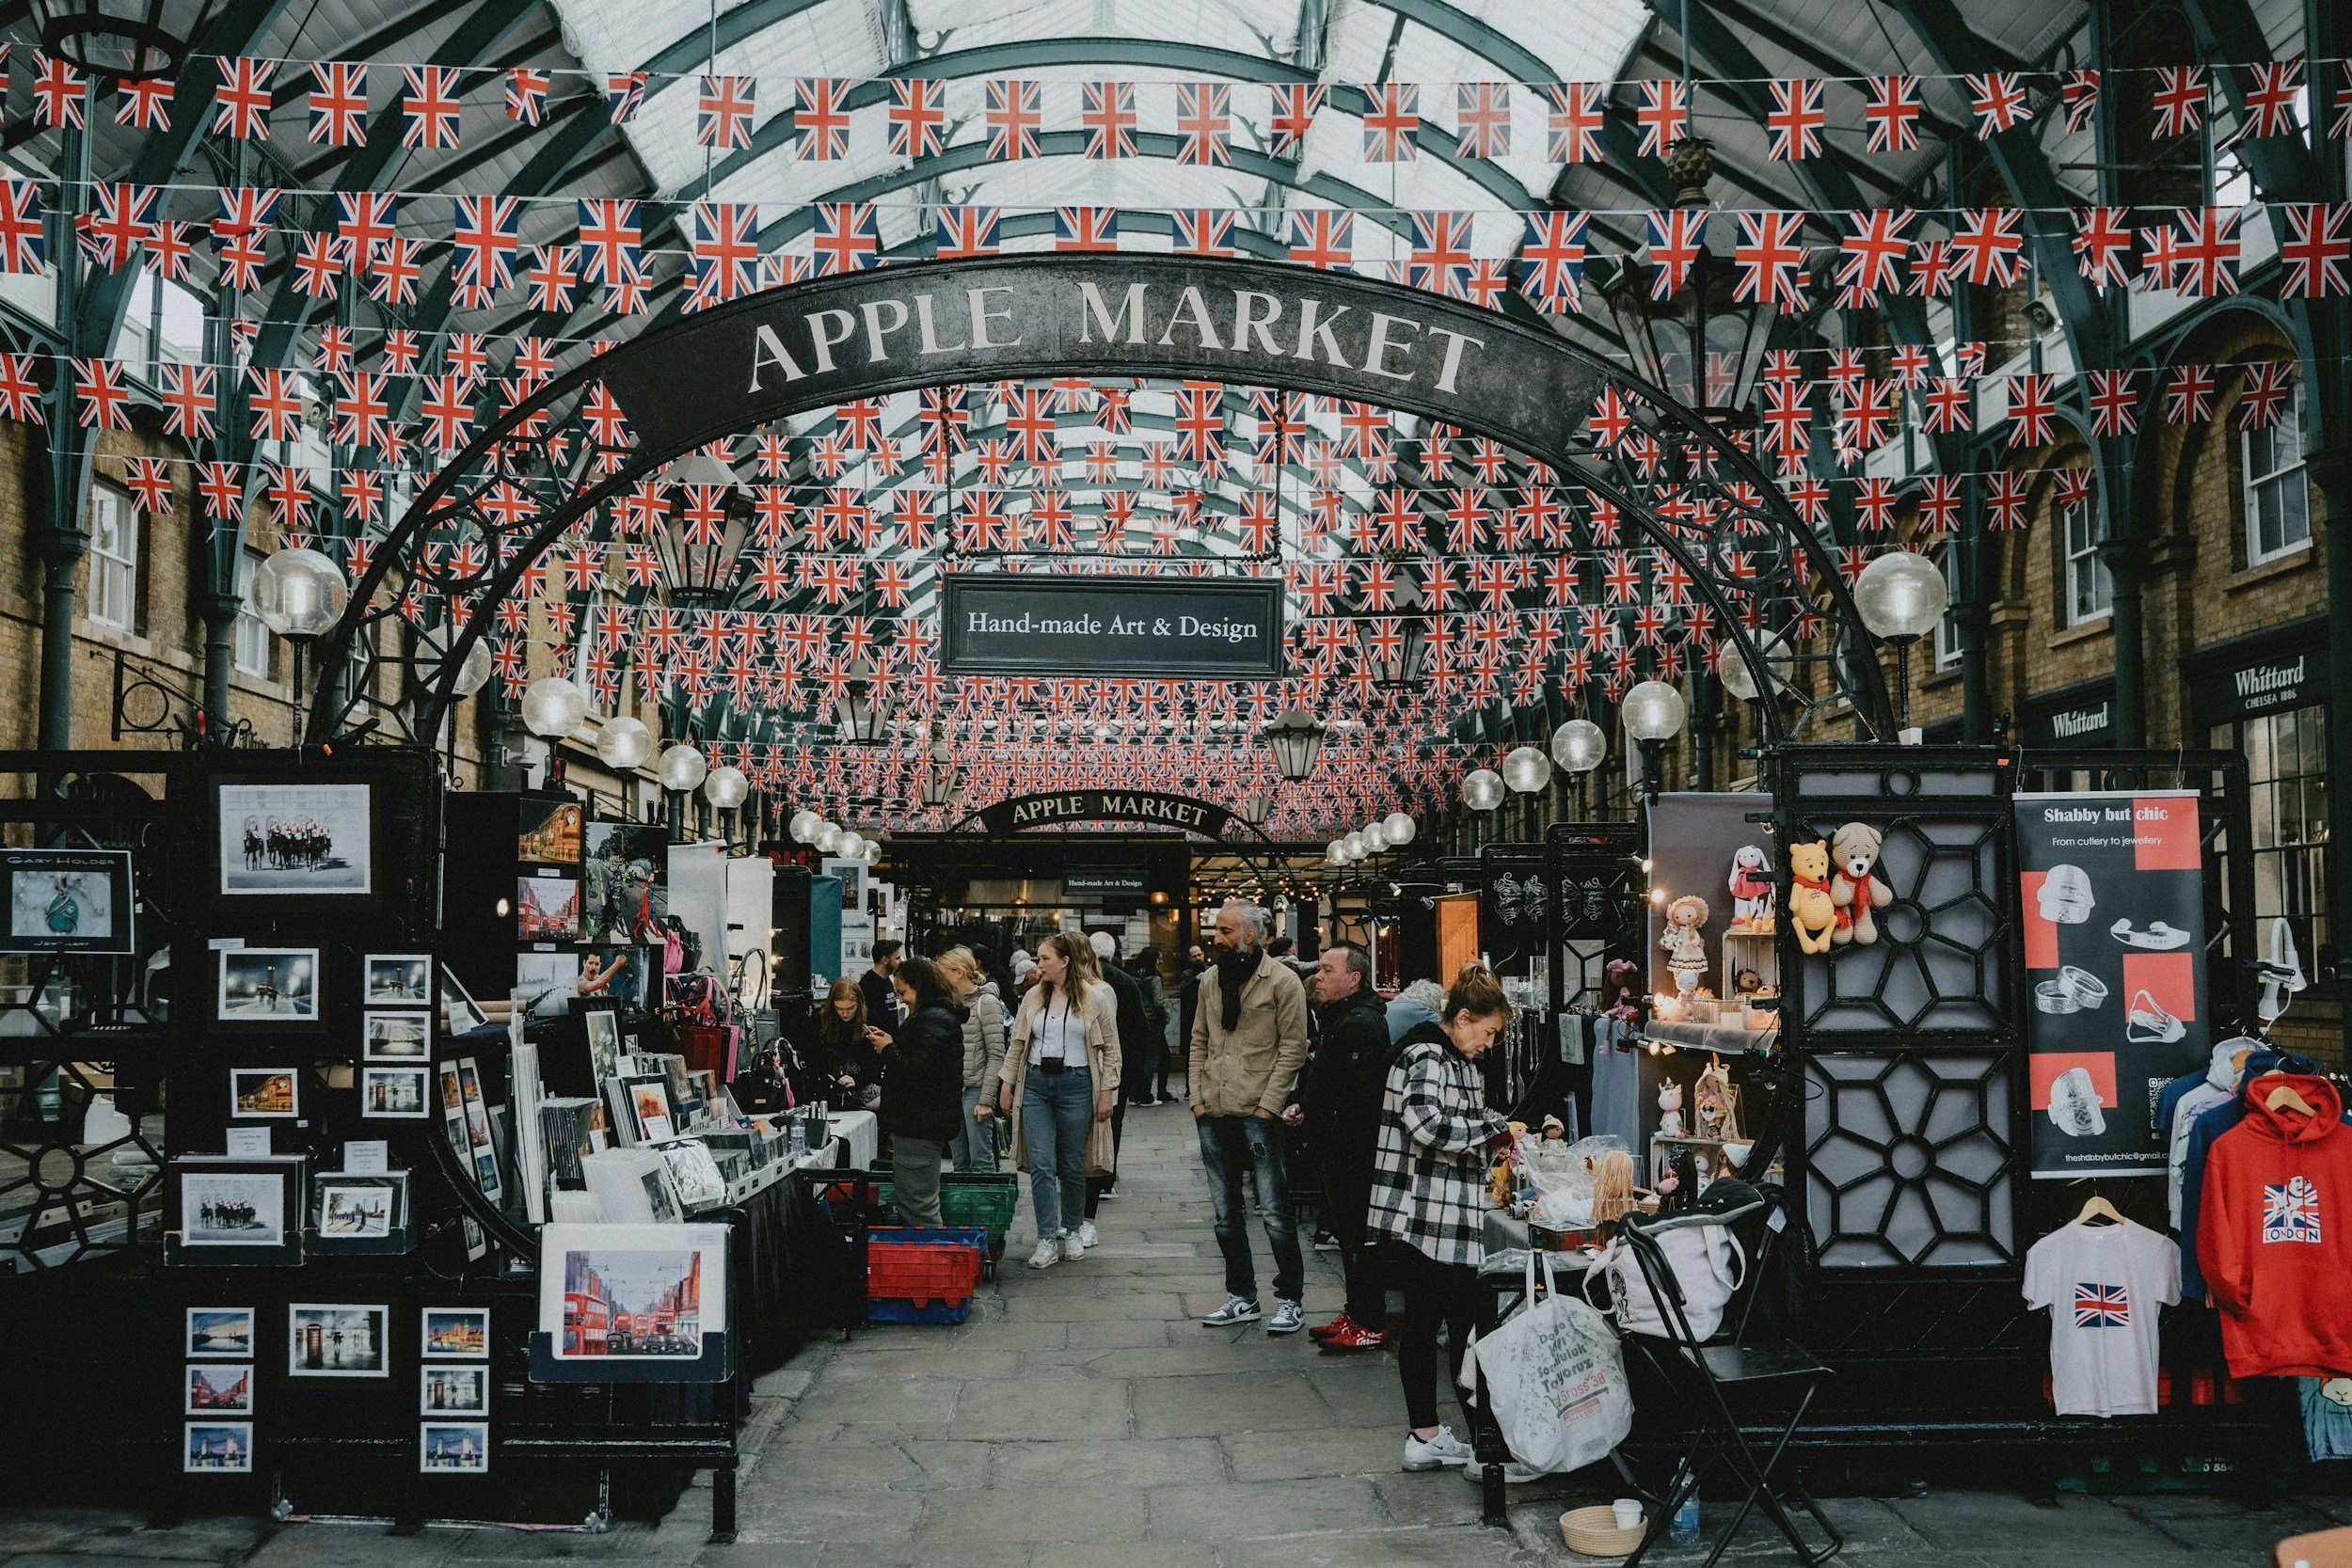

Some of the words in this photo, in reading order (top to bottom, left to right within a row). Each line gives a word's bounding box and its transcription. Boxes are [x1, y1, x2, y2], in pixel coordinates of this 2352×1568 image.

[748, 286, 1023, 394] APPLE
[1077, 282, 1485, 395] MARKET
[967, 612, 1102, 635] Hand-made
[1107, 614, 1145, 635] Art
[1152, 618, 1171, 636] &
[1179, 615, 1258, 643] Design
[2234, 655, 2305, 697] Whittard
[2245, 695, 2278, 709] CHELSEA
[2280, 689, 2297, 703] 1886
[2052, 702, 2108, 738] Whittard
[1012, 796, 1085, 824] APPLE
[1102, 796, 1207, 826] MARKET
[2043, 807, 2101, 824] Shabby
[2105, 807, 2131, 821] but
[2136, 807, 2169, 821] chic
[2052, 837, 2075, 846] From
[2077, 837, 2108, 847] cutlery
[2110, 836, 2121, 846] to
[2122, 836, 2162, 847] jewellery
[7, 856, 52, 864] GARY
[1121, 879, 1142, 888] Design
[2265, 1228, 2318, 1241] LONDON
[1561, 1382, 1590, 1402] Gross
[1590, 1372, 1606, 1387] 38
